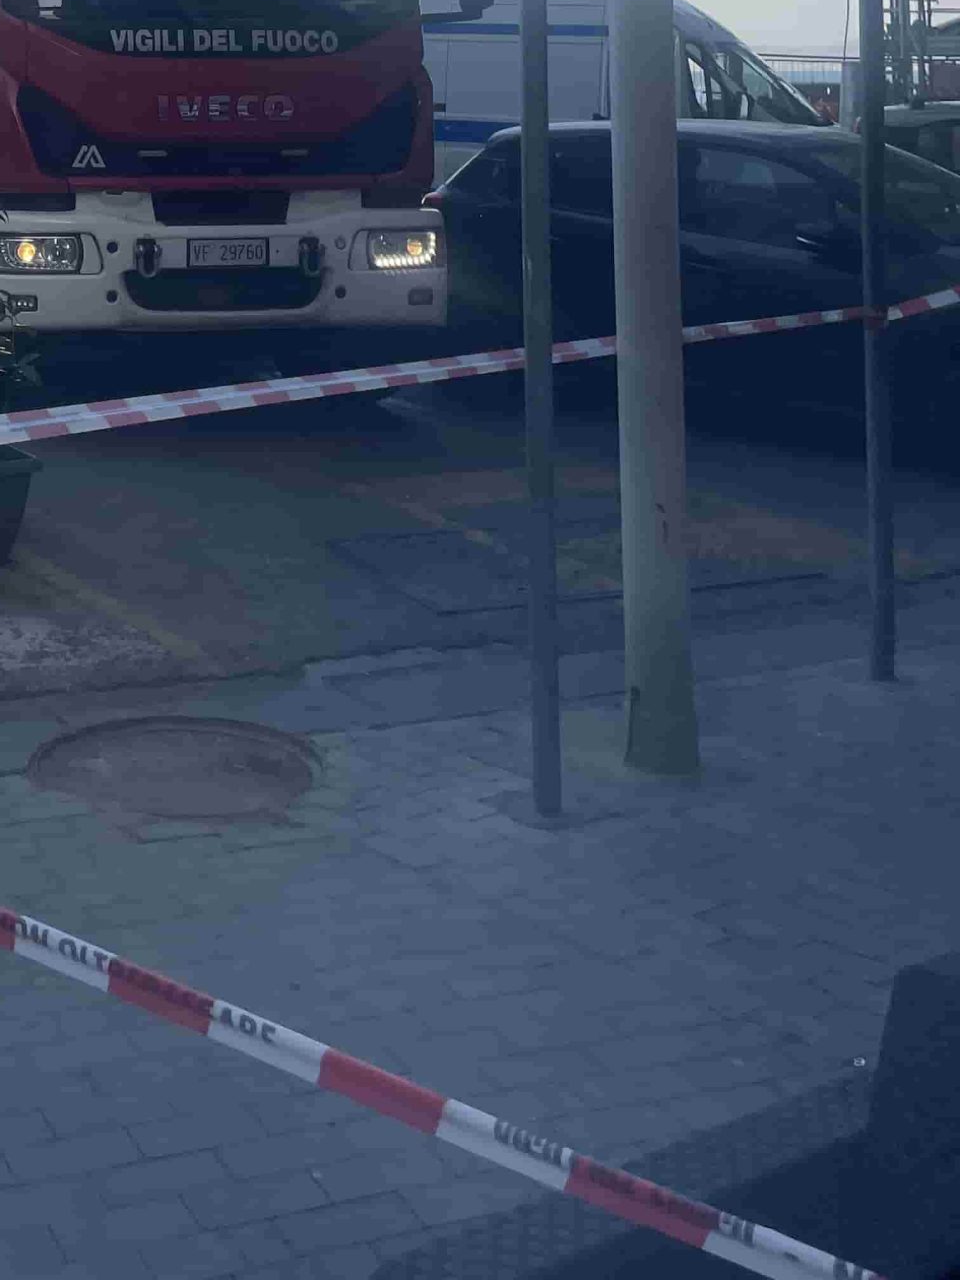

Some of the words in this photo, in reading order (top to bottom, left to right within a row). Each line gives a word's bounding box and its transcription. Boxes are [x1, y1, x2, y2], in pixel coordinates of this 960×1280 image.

[110, 29, 184, 52] VIGILI
[193, 29, 243, 52] DEL
[251, 29, 338, 53] FUOCO
[158, 94, 294, 121] IVECO
[193, 245, 209, 261] VF
[220, 244, 263, 261] 29760
